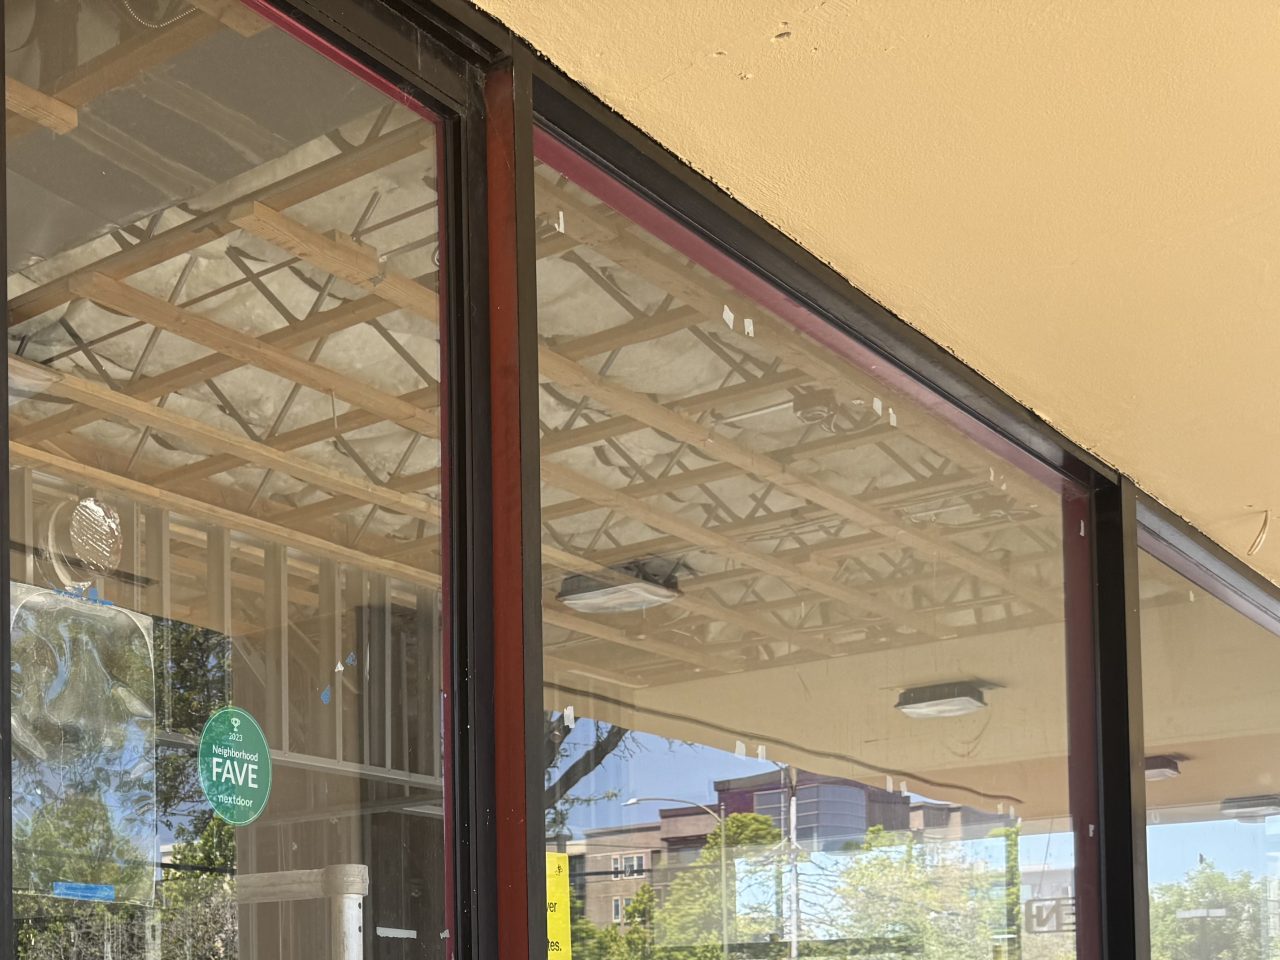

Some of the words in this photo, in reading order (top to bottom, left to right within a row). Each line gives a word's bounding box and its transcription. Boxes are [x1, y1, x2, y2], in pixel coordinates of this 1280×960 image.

[228, 732, 243, 742] 2023
[212, 744, 259, 762] Neighborhood
[212, 757, 259, 789] FAVE
[218, 794, 254, 808] nextdoor
